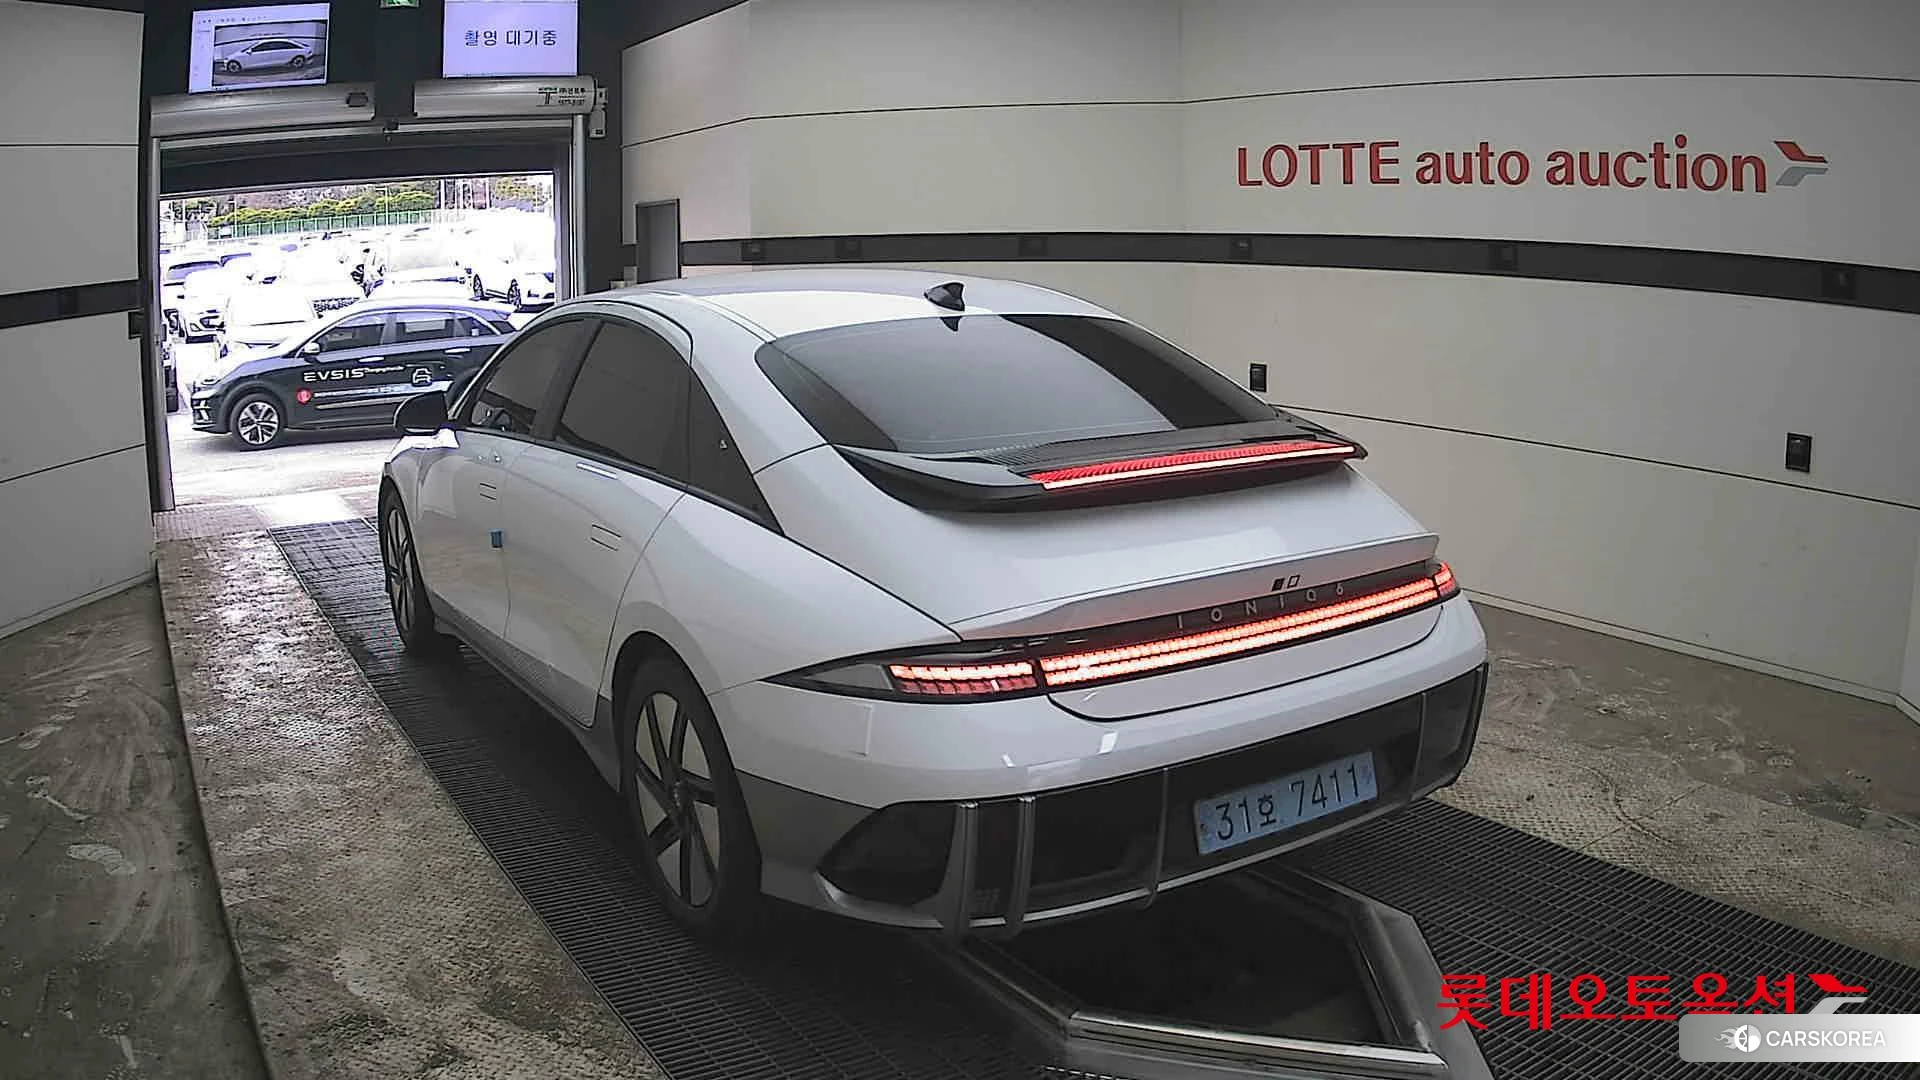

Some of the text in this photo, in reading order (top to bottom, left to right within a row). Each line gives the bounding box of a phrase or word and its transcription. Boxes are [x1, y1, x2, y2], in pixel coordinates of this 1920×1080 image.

[465, 30, 498, 47] 촬영
[1237, 135, 1767, 193] LOTTE auto auction
[303, 368, 364, 383] EVSIS
[1290, 763, 1360, 817] 7411
